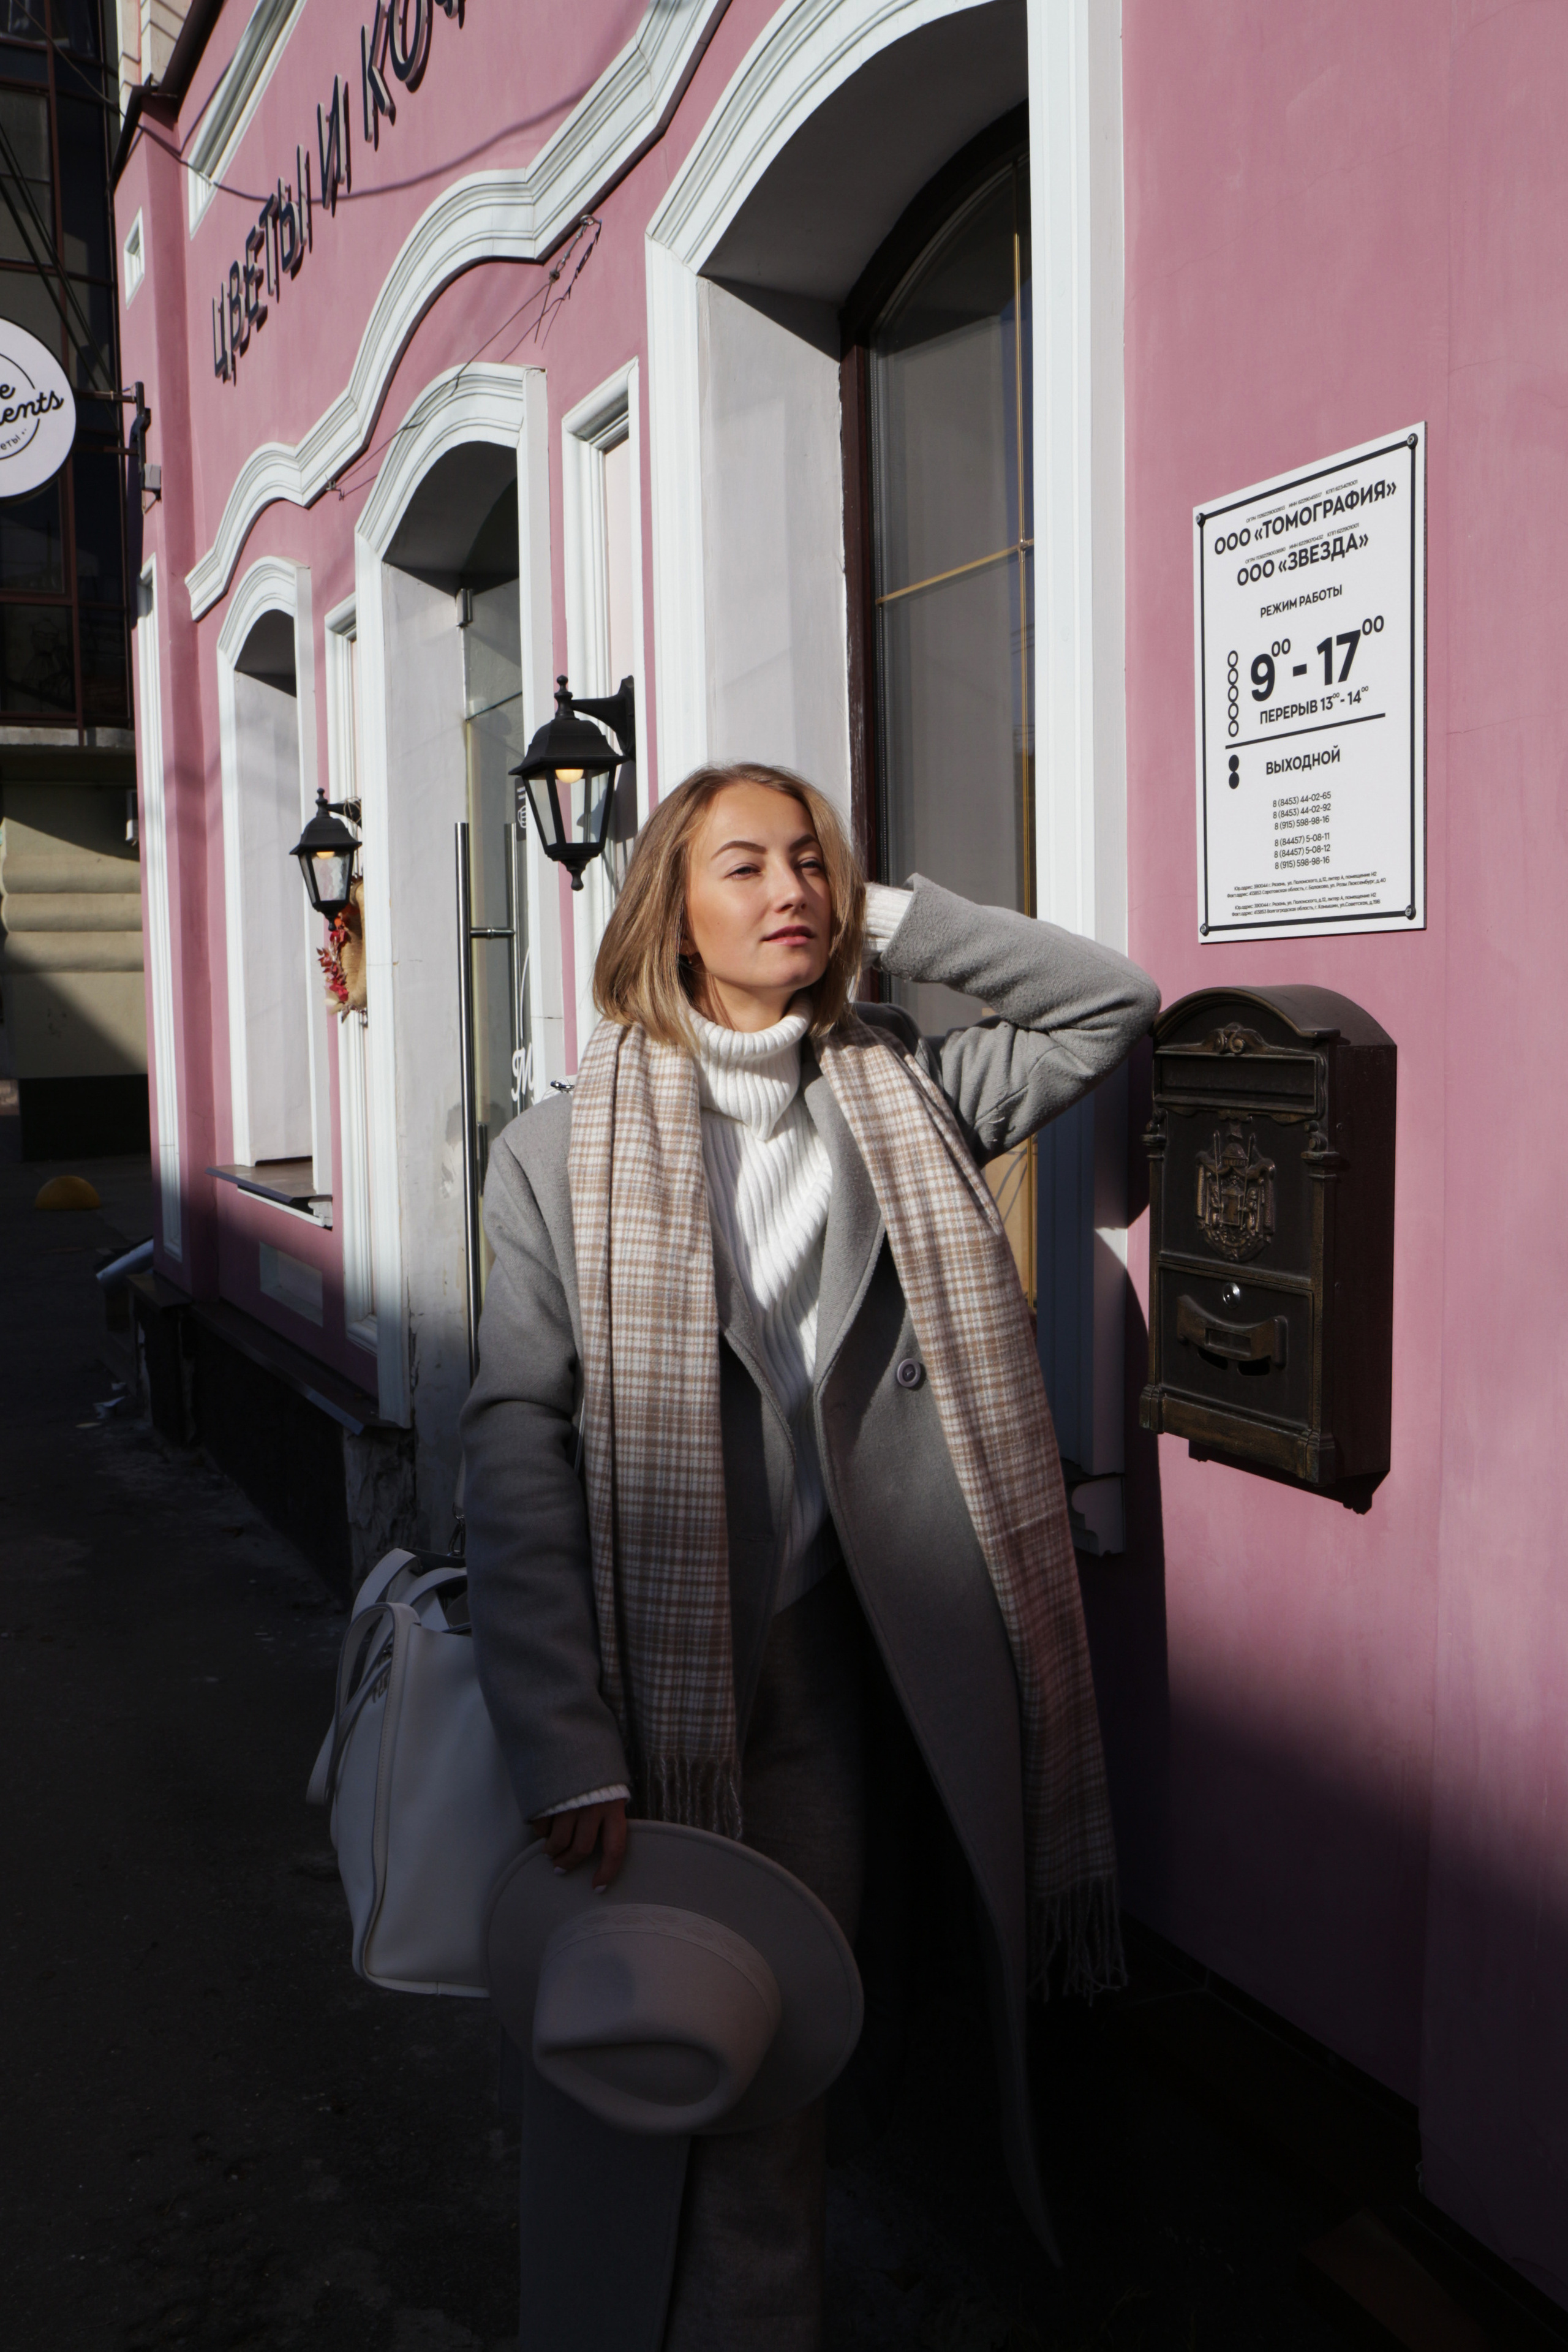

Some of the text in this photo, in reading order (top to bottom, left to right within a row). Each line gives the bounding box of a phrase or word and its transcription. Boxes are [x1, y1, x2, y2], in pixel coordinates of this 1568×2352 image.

[213, 0, 459, 379] ЦВЕТЫ И КО
[0, 390, 64, 426] ents
[1215, 480, 1396, 554] ООО «ТОМОГРАФИЯ»
[1237, 533, 1368, 586] ООО «ЗВЕЗДА»
[1261, 584, 1342, 617] РЕЖИМ РАБОТЫ
[1261, 699, 1317, 724] ПЕРЕРЫВ
[1266, 745, 1340, 775] ВЫХОДНОЙ
[1278, 796, 1299, 807] (8453)
[1300, 791, 1331, 802] 44-02-65
[1278, 808, 1299, 818] (8453)
[1300, 803, 1331, 814] 44-02-92
[1280, 820, 1295, 830] (915)
[1297, 815, 1329, 827] 598-98-16
[1280, 835, 1305, 846] (84457)
[1306, 832, 1329, 842] 5-08-11
[1280, 847, 1304, 858] (84457)
[1306, 844, 1330, 854] 5-08-12
[1280, 860, 1295, 869] (915)
[1297, 856, 1330, 867] 598-98-16
